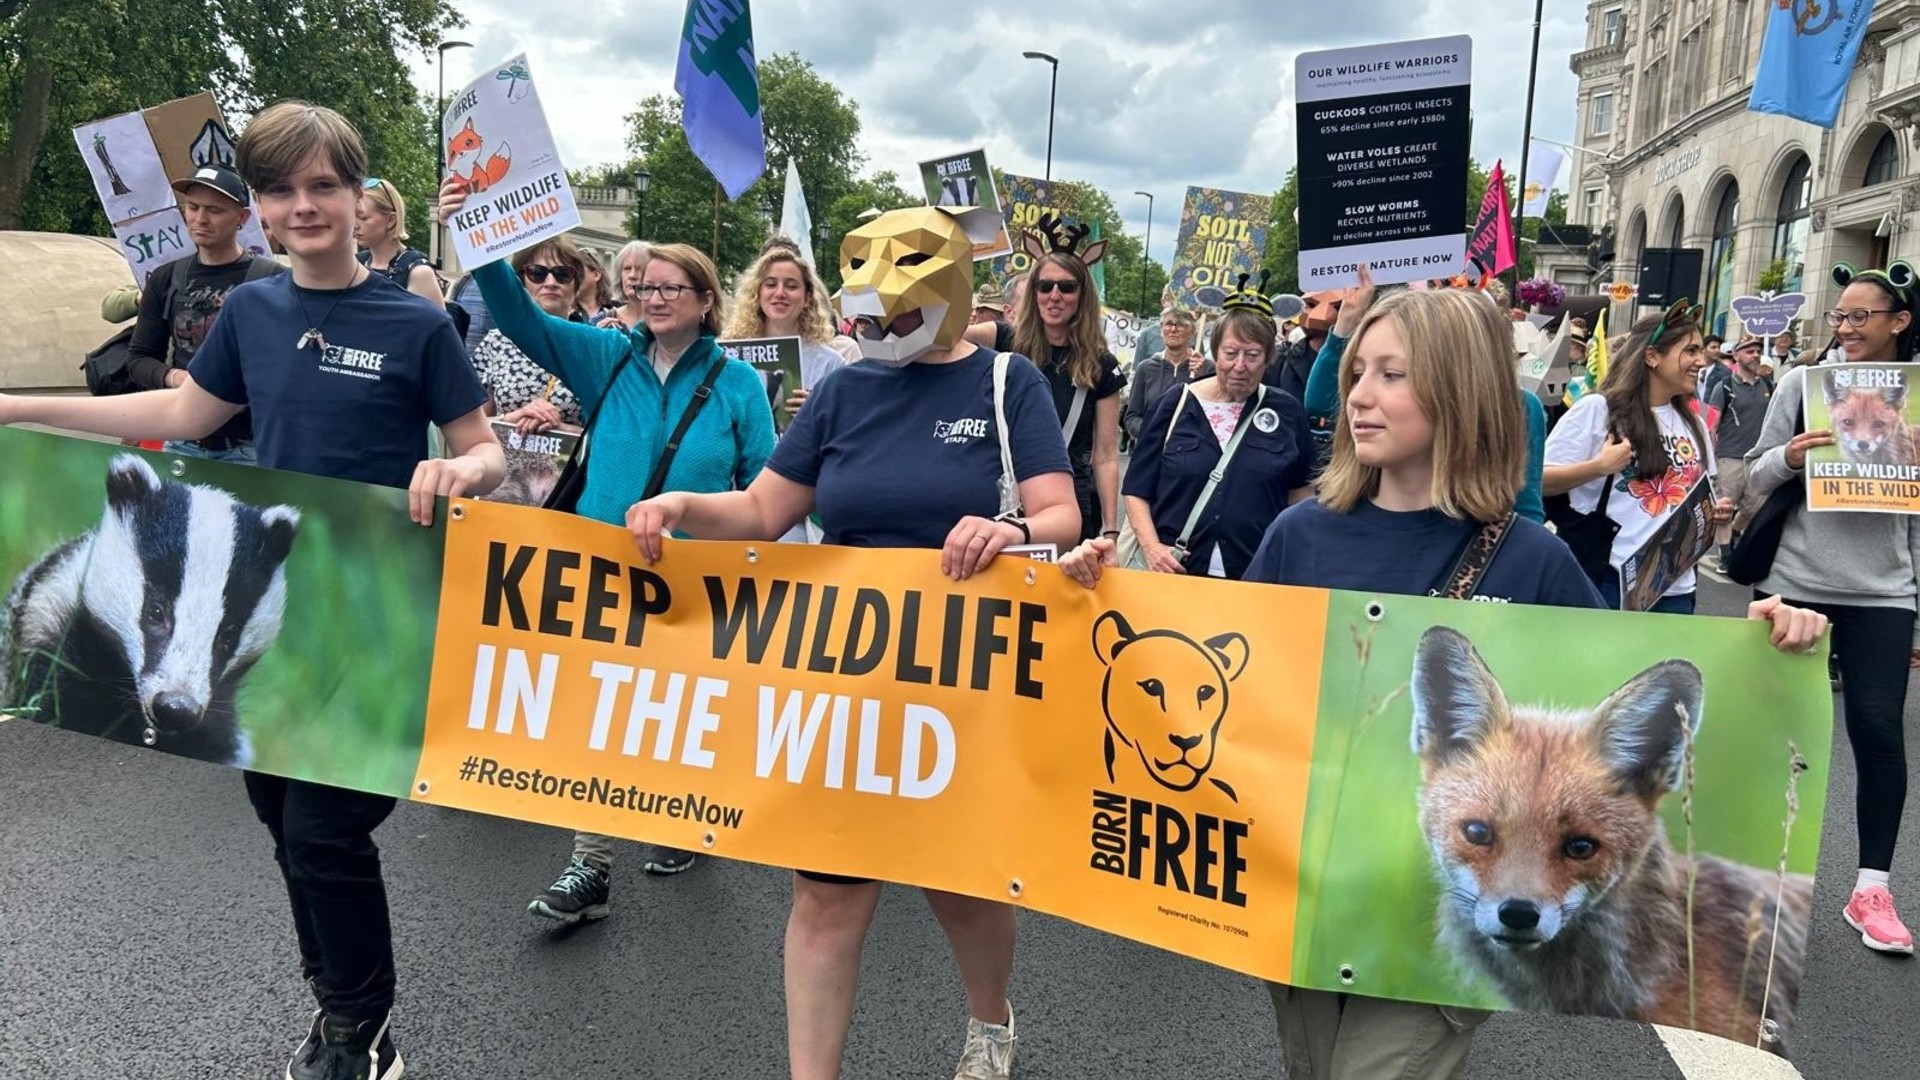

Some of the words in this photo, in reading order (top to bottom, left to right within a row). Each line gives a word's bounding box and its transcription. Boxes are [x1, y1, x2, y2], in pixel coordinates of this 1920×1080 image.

[1308, 69, 1333, 79] OUR
[1336, 61, 1391, 76] WILDLIFE
[1395, 54, 1459, 69] WARRIORS
[457, 89, 479, 116] FREE
[1314, 107, 1367, 121] CUCKOOS
[1369, 101, 1413, 115] CONTROL
[1415, 97, 1453, 110] INSECTS
[1320, 126, 1338, 135] 65%
[1340, 122, 1371, 133] decline
[1372, 120, 1395, 129] since
[1397, 115, 1419, 127] early
[1421, 113, 1446, 123] 1980s
[1327, 151, 1364, 162] WATER
[1367, 146, 1401, 158] VOLES
[1403, 142, 1438, 154] CREATE
[1337, 161, 1375, 172] DIVERSE
[1377, 154, 1427, 168] WETLANDS
[952, 157, 973, 174] FREE
[1331, 180, 1355, 188] >90%
[1356, 175, 1388, 186] decline
[1388, 173, 1411, 183] since
[1412, 170, 1433, 180] 2002
[454, 205, 491, 232] KEEP
[494, 172, 562, 215] WILDLIFE
[1344, 204, 1376, 215] SLOW
[1378, 200, 1420, 212] WORMS
[469, 230, 488, 249] IN
[489, 215, 519, 237] THE
[520, 196, 561, 226] WILD
[1196, 214, 1251, 242] SOIL
[1337, 216, 1375, 227] RECYCLE
[1377, 210, 1427, 223] NUTRIENTS
[485, 220, 554, 254] #RestoreNatureNow
[1343, 229, 1372, 240] decline
[1374, 228, 1402, 237] across
[1403, 225, 1418, 234] the
[1419, 224, 1431, 232] UK
[1203, 240, 1237, 267] NOT
[1370, 256, 1419, 271] NATURE
[1422, 253, 1453, 265] NOW
[1192, 266, 1236, 290] OIL
[353, 349, 384, 371] FREE
[752, 344, 780, 363] FREE
[319, 365, 339, 374] YOUTH
[339, 369, 381, 381] AMBASSADOR
[1867, 368, 1902, 388] FREE
[958, 418, 989, 438] FREE
[534, 436, 563, 456] FREE
[1814, 462, 1851, 477] KEEP
[1856, 463, 1920, 481] WILDLIF
[1823, 480, 1840, 495] IN
[1846, 481, 1875, 496] THE
[1880, 483, 1920, 498] WILD
[482, 541, 672, 648] KEEP
[703, 576, 1048, 700] WILDLIFE
[467, 643, 560, 740] IN
[588, 660, 730, 770] THE
[755, 685, 957, 800] WILD
[459, 755, 744, 829] #RestoreNatureNow
[1090, 789, 1128, 876] BORN
[1127, 798, 1249, 908] FREE
[1157, 905, 1189, 921] Registered
[1189, 913, 1210, 928] Charity
